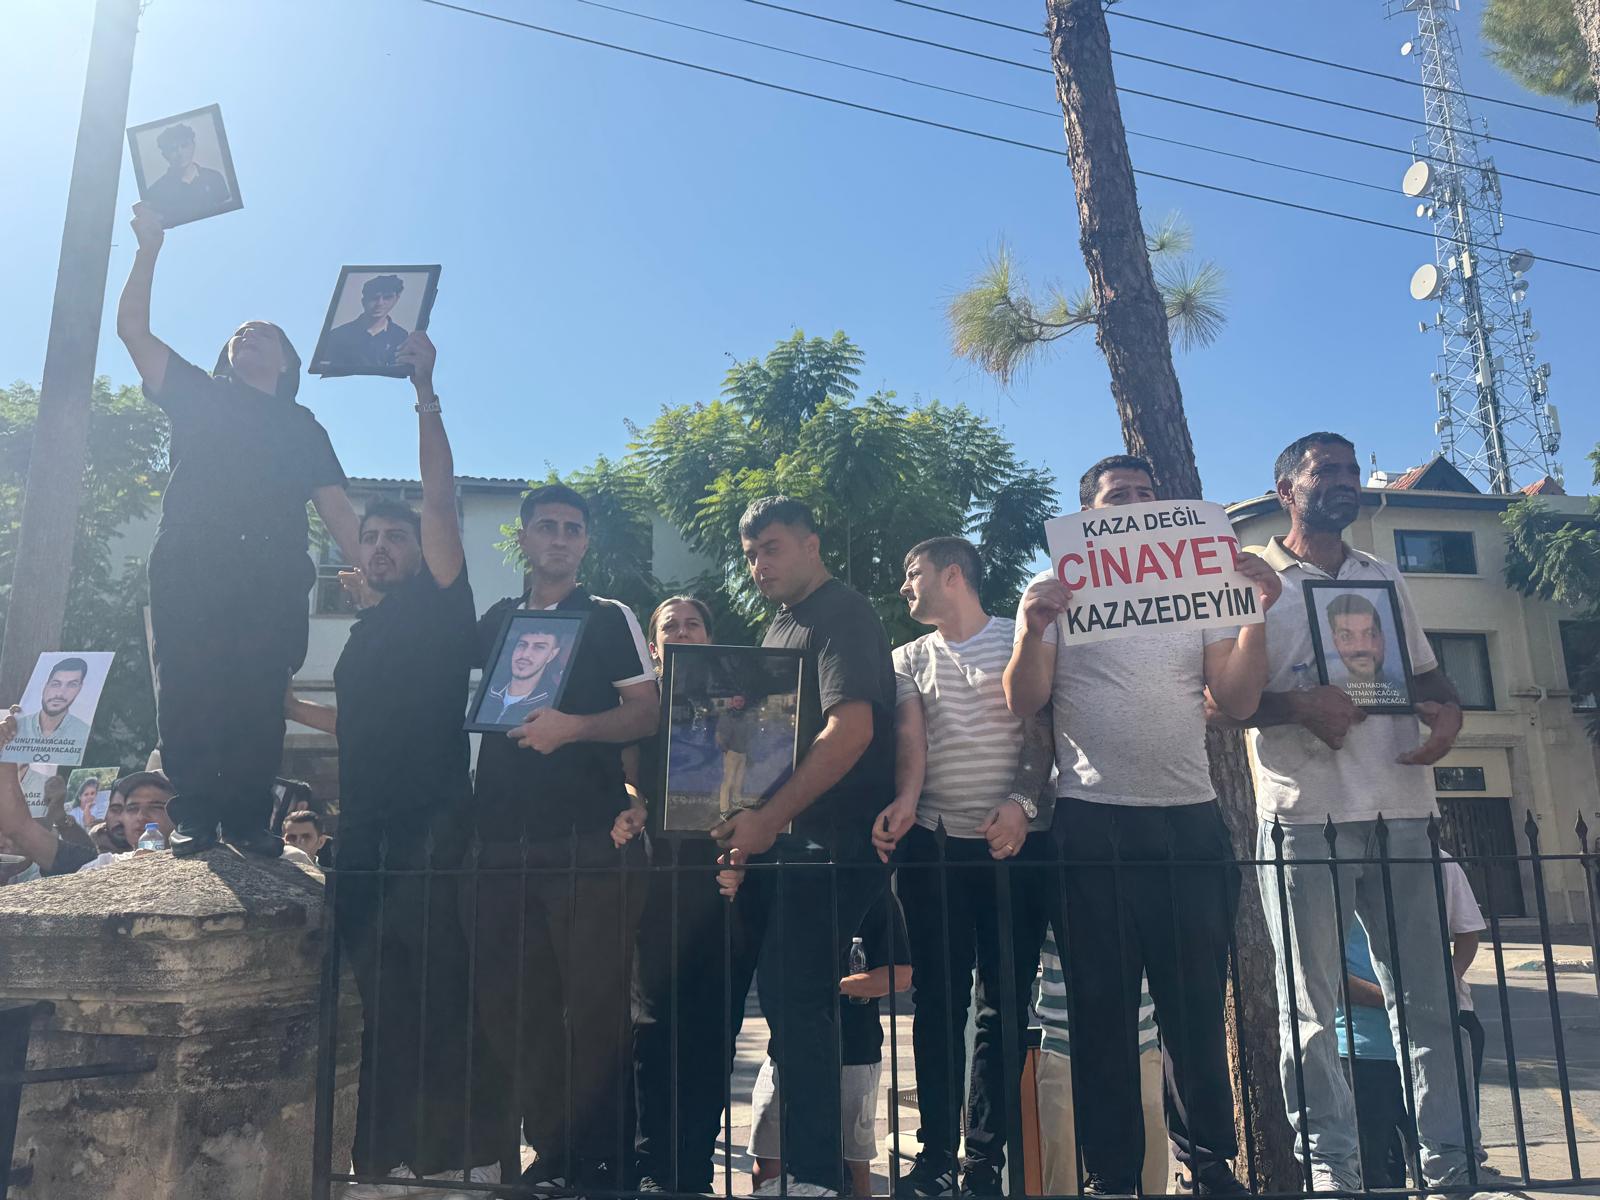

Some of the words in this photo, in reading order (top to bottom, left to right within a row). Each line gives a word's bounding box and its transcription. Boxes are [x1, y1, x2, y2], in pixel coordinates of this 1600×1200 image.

[1083, 515, 1140, 538] KAZA
[1144, 506, 1206, 531] DEĞİL
[1057, 535, 1240, 592] CİNAYET
[1067, 582, 1257, 635] KAZAZEDEYİM
[5, 745, 82, 754] UNUTTURMAYACAĞIZ
[14, 737, 76, 746] UNUTMAYACAĞIZ
